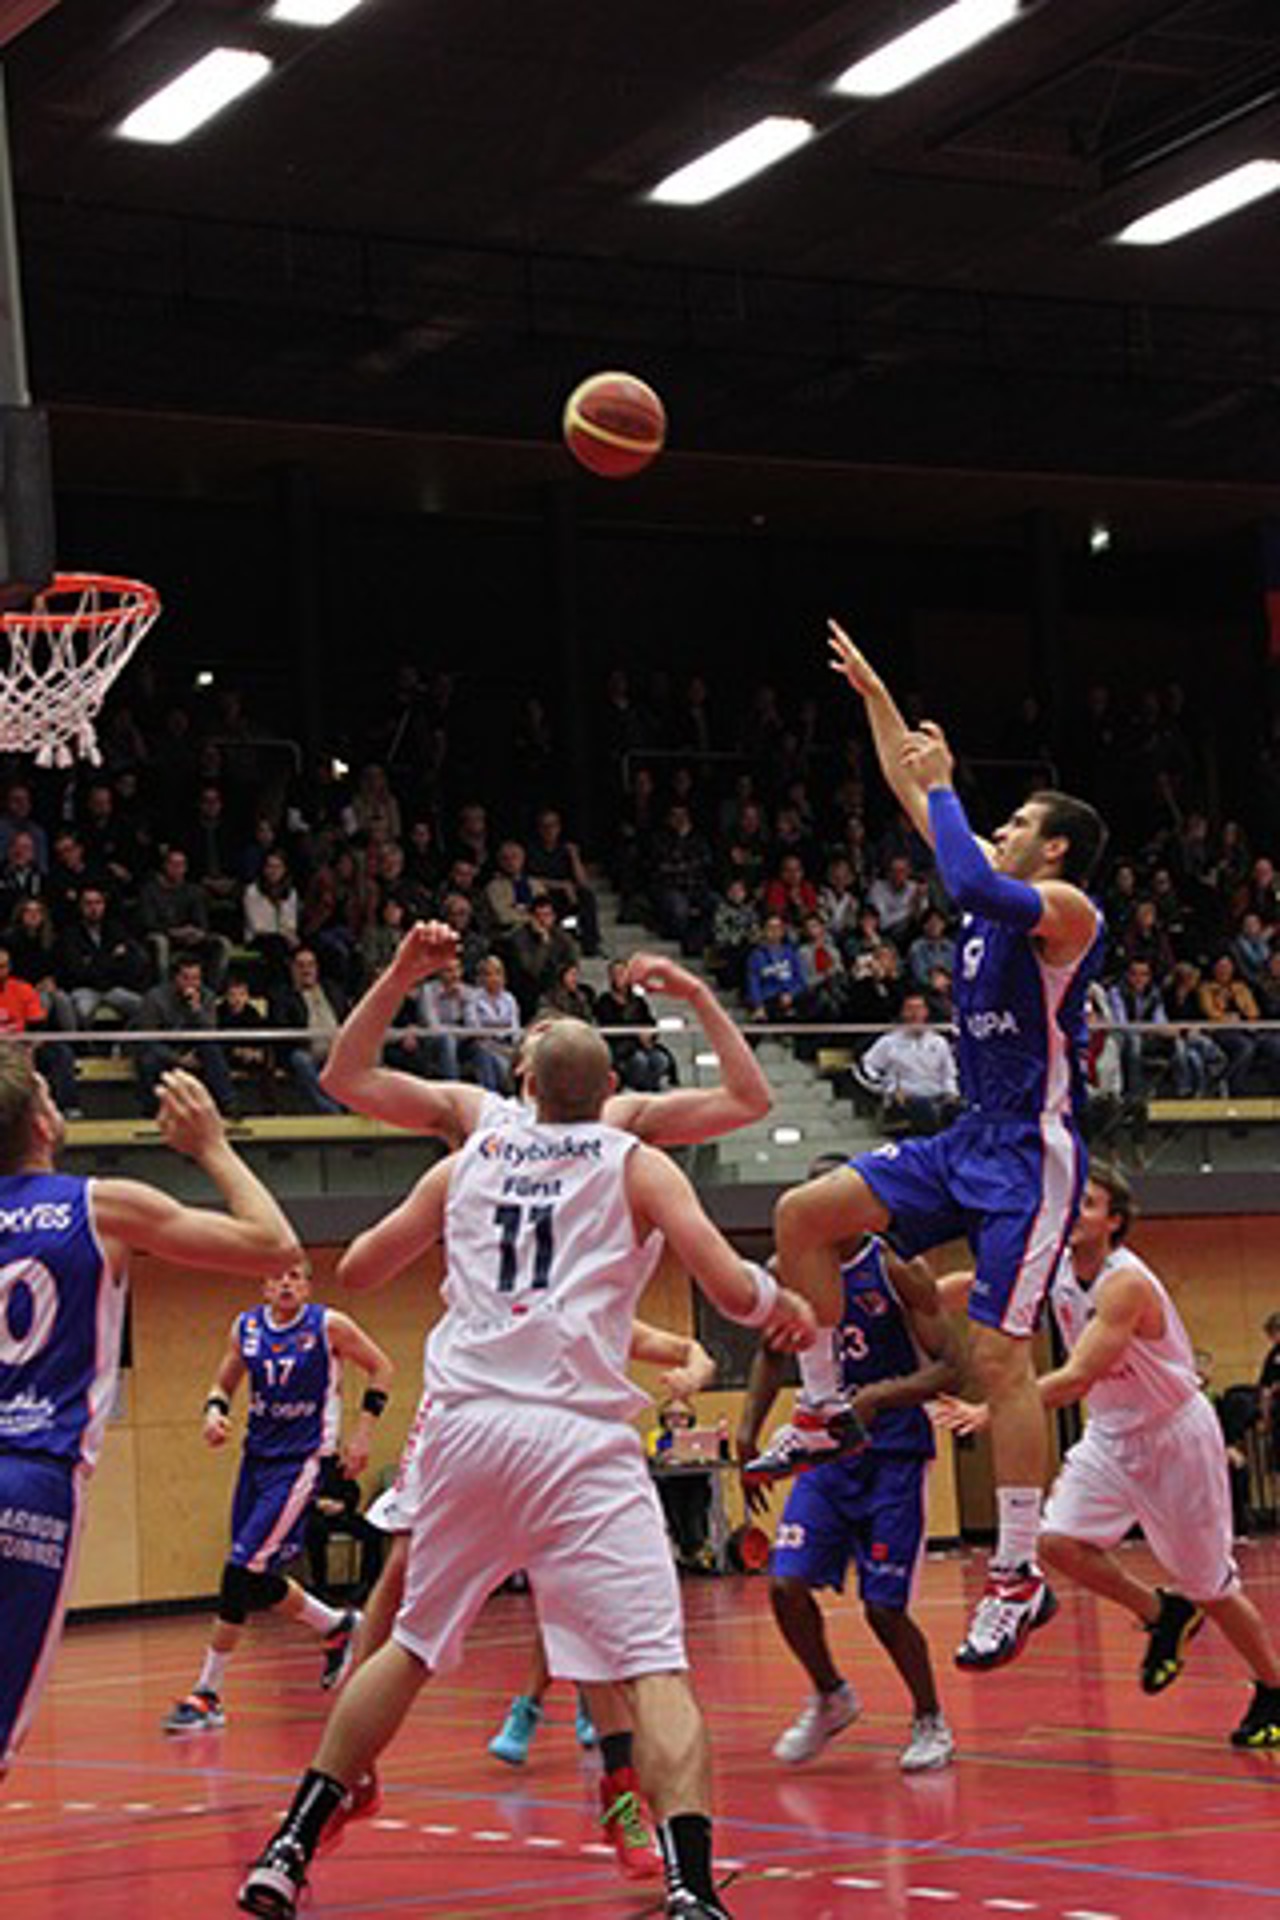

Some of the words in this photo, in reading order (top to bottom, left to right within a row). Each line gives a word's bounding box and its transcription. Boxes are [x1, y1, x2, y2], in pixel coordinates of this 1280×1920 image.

[962, 936, 985, 980] 9
[493, 1203, 553, 1293] 11
[838, 1325, 869, 1361] 3
[262, 1358, 297, 1387] 17
